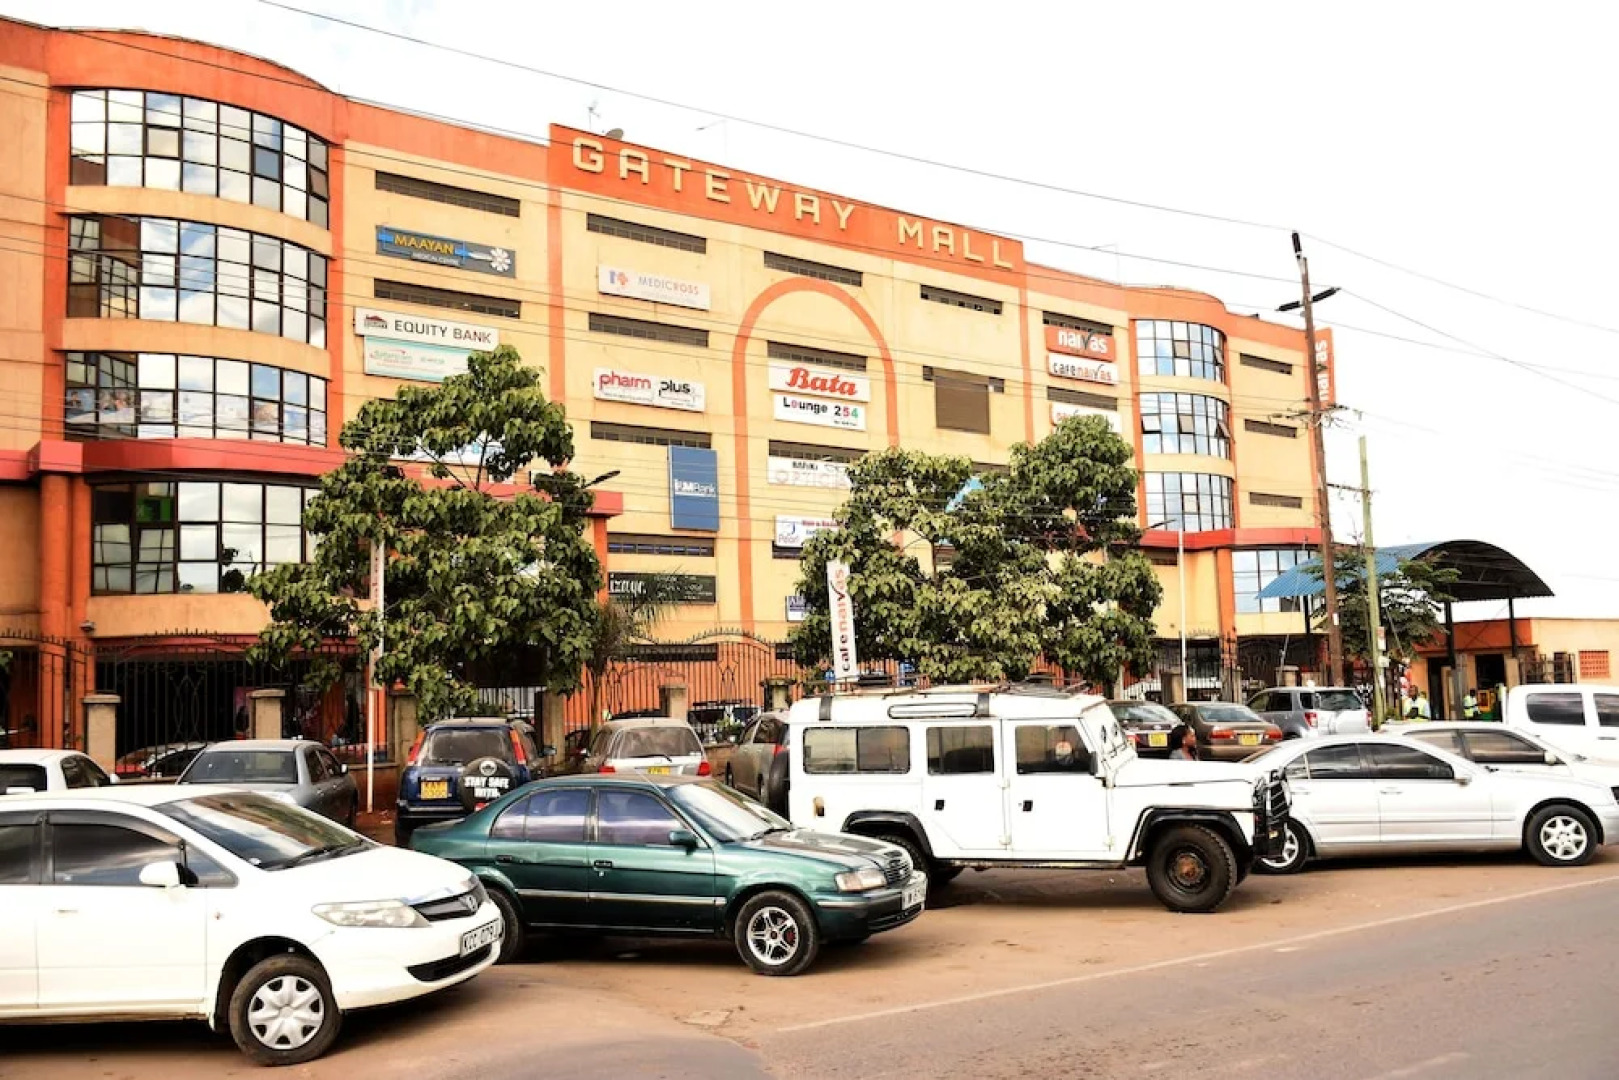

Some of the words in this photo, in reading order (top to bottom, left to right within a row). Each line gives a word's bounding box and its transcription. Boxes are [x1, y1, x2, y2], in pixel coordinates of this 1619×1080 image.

[572, 136, 856, 231] GATEWAY
[898, 216, 1013, 269] MALL
[394, 234, 455, 255] MAAYAN
[638, 275, 700, 296] MEDICROSS
[394, 319, 448, 338] EQUITY
[452, 328, 492, 344] BANK
[1057, 328, 1108, 354] naivas
[599, 371, 651, 391] pharm
[659, 380, 691, 397] plus
[785, 366, 858, 396] Bata
[782, 396, 828, 414] Lounge
[833, 405, 859, 419] 254
[464, 776, 486, 788] STAY
